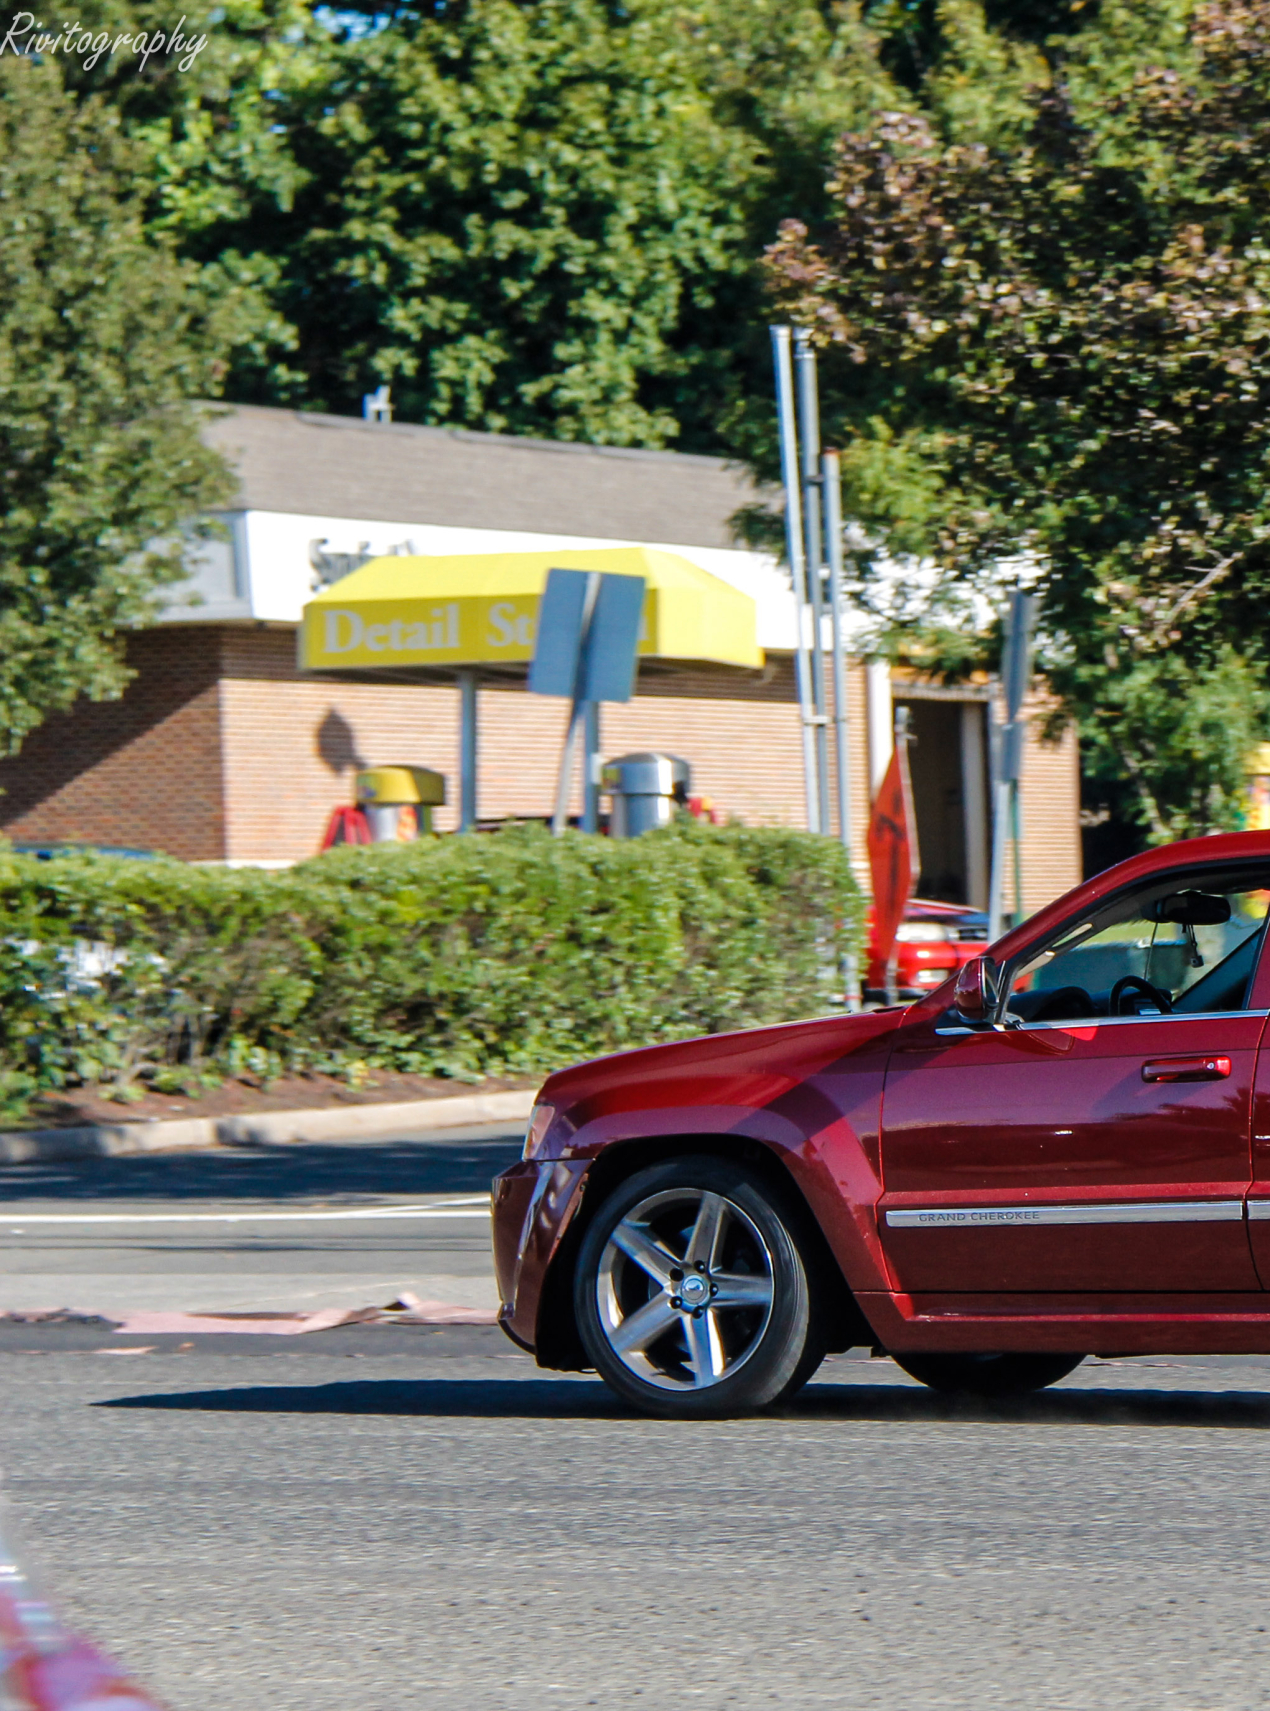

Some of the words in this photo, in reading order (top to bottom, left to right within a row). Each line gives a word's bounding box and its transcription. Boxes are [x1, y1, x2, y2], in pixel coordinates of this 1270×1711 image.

[322, 603, 460, 653] Detail
[918, 1212, 966, 1222] GRAND
[970, 1210, 1040, 1221] CHEROKEE
